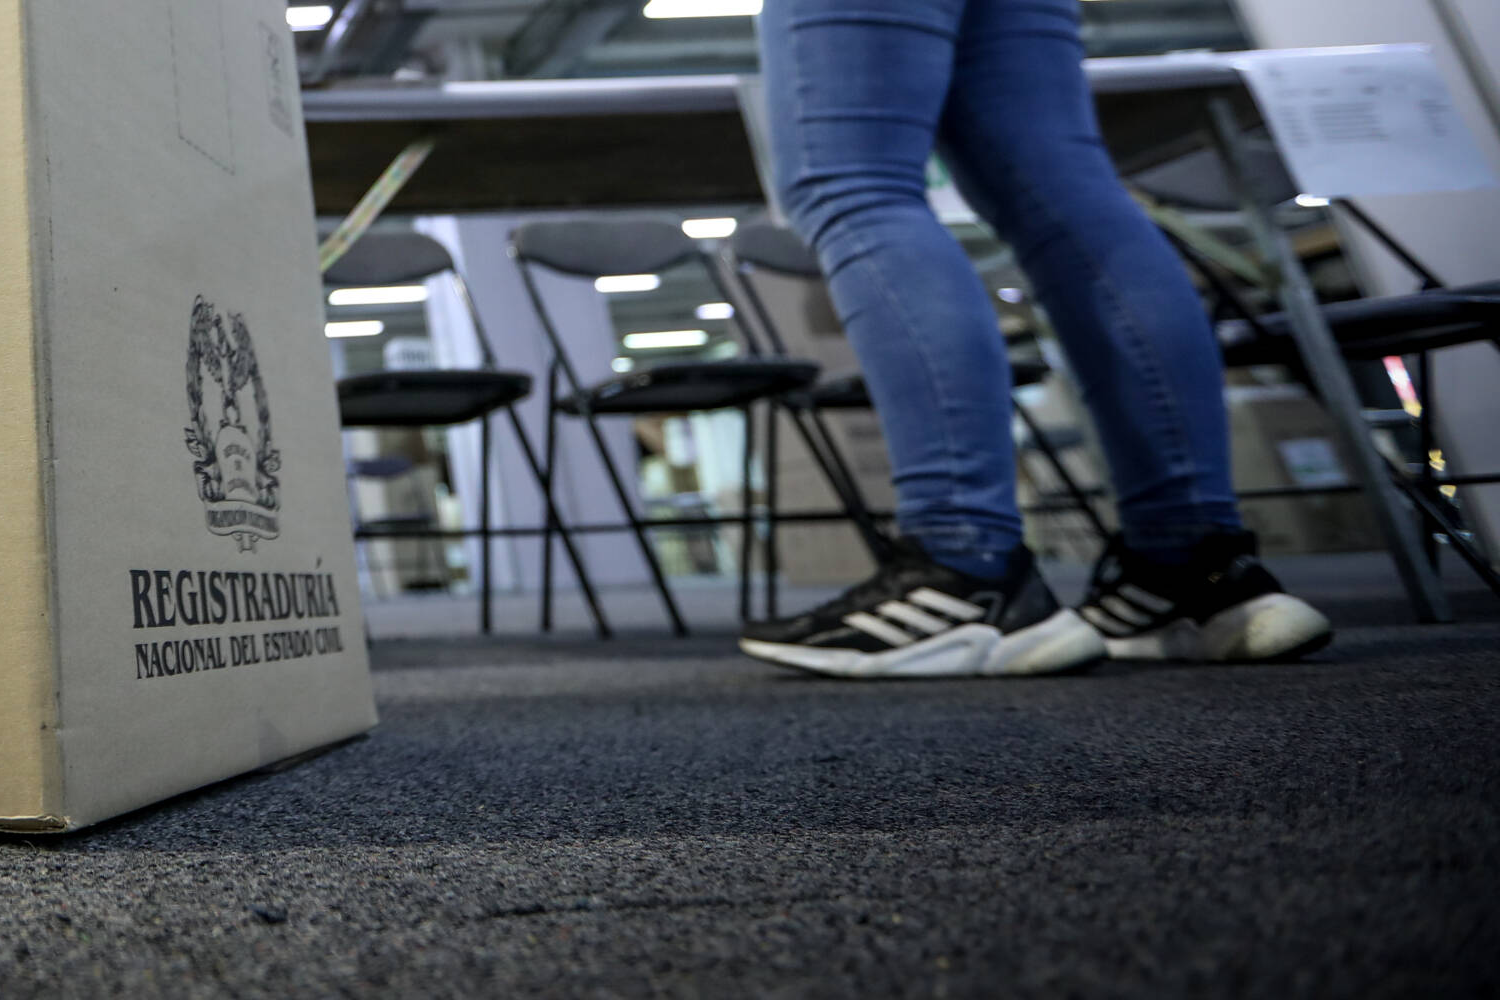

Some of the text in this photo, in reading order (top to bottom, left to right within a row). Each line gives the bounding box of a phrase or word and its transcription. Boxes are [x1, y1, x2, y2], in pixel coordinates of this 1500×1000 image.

[130, 557, 339, 629] REGISTRADURÍA
[135, 627, 344, 680] NACIONAL DEL ESTADO CIVIL
